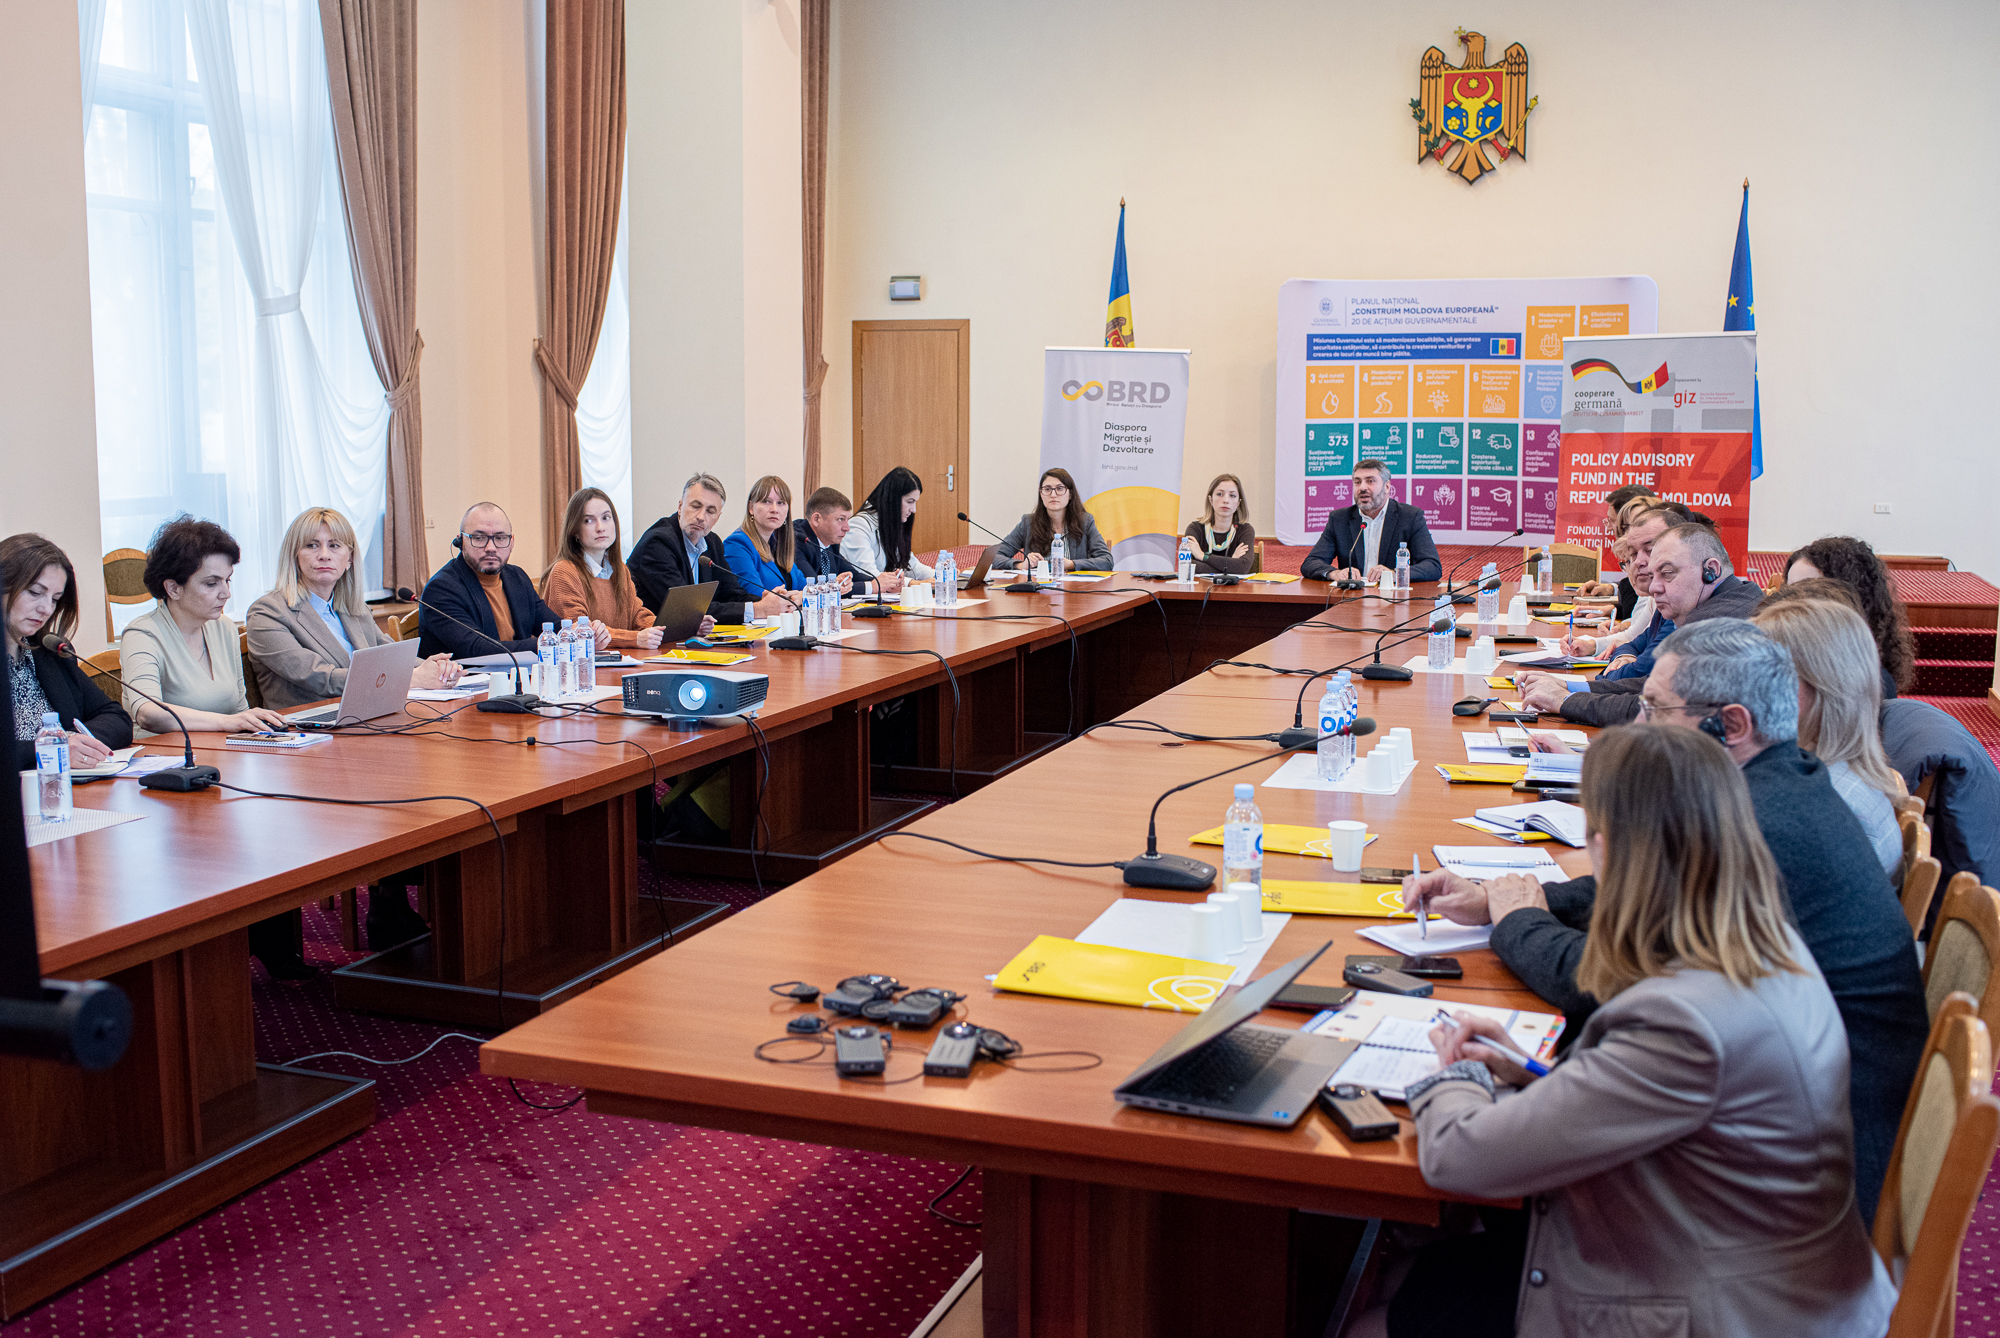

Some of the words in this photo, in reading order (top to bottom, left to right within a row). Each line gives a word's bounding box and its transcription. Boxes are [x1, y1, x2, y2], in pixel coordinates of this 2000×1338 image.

[1382, 298, 1420, 306] NAȚIONAL
[1374, 318, 1403, 326] ACȚIUNI
[1405, 316, 1477, 325] GUVERNAMENTALE
[1531, 316, 1535, 325] 1
[1583, 315, 1588, 325] 2
[1310, 373, 1316, 384] 3
[1363, 373, 1368, 383] 4
[1417, 372, 1422, 382] 5
[1473, 372, 1479, 382] 6
[1528, 372, 1533, 383] 7
[1107, 380, 1170, 403] BRD
[1674, 390, 1696, 408] giz
[1574, 398, 1622, 411] germană
[1104, 422, 1147, 432] Diaspora
[1104, 433, 1142, 444] Migrație
[1144, 435, 1151, 445] și
[1308, 430, 1314, 440] 9
[1362, 429, 1371, 439] 10
[1416, 429, 1424, 439] 11
[1472, 429, 1481, 439] 12
[1526, 430, 1535, 440] 13
[1328, 436, 1348, 446] 373
[1103, 444, 1154, 454] Dezvoltare
[1572, 453, 1620, 466] POLICY
[1622, 454, 1695, 467] ADVISORY
[1570, 472, 1606, 485] FUND
[1609, 473, 1622, 485] IN
[1626, 473, 1655, 485] THE
[1308, 486, 1317, 496] 15
[1415, 486, 1424, 496] 17
[1471, 487, 1480, 497] 18
[1525, 488, 1534, 499] 19
[1662, 492, 1732, 506] MOLDOVA
[1567, 526, 1602, 535] FONDUL
[1566, 538, 1602, 548] POLITICI
[1604, 537, 1614, 548] ÎN
